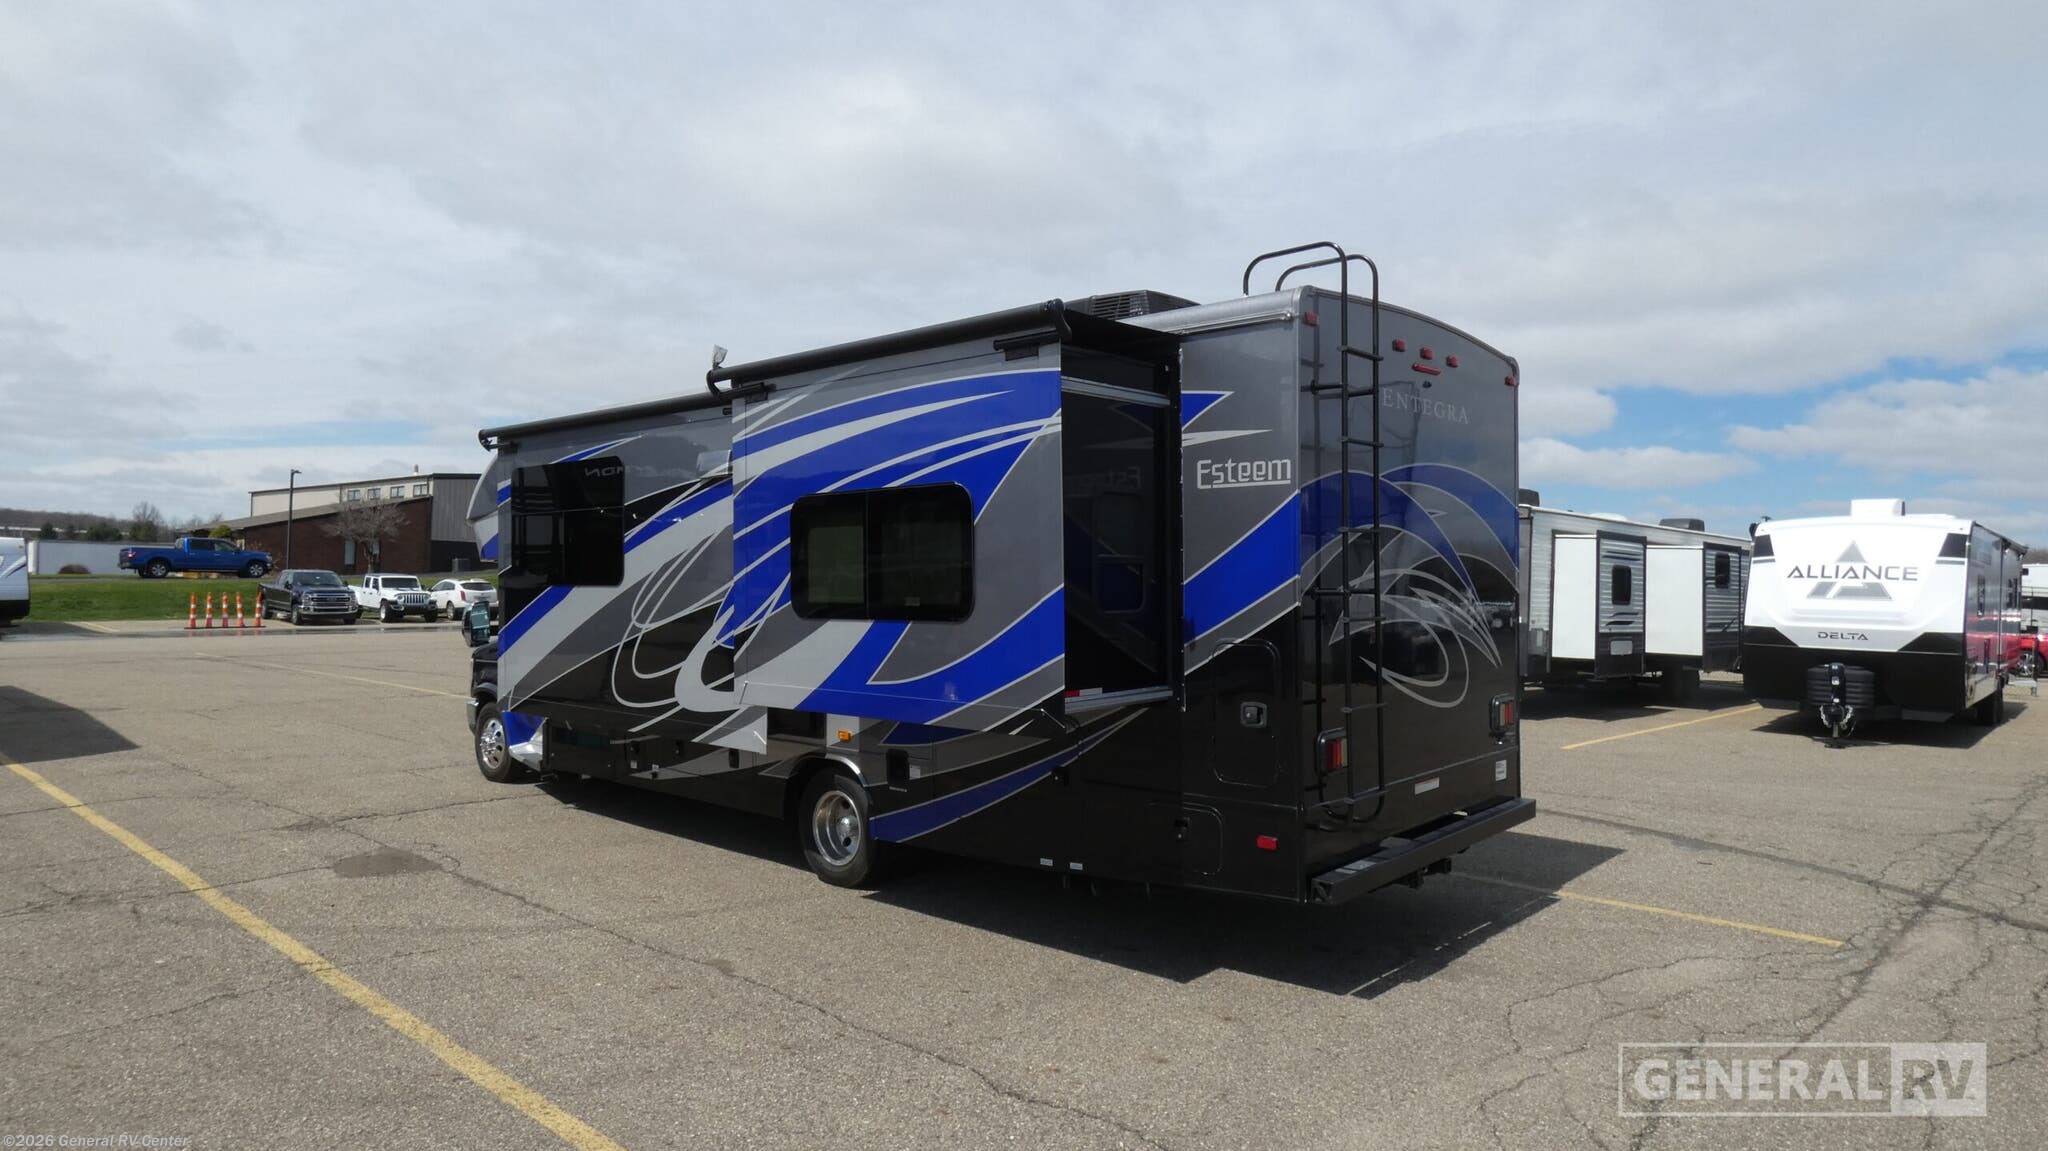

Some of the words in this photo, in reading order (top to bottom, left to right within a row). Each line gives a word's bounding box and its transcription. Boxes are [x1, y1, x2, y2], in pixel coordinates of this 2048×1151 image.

[1383, 387, 1469, 425] ENTEGRA
[1197, 458, 1291, 489] Esteem
[1787, 564, 1918, 582] ALLIANCE
[1817, 631, 1869, 641] DELTA
